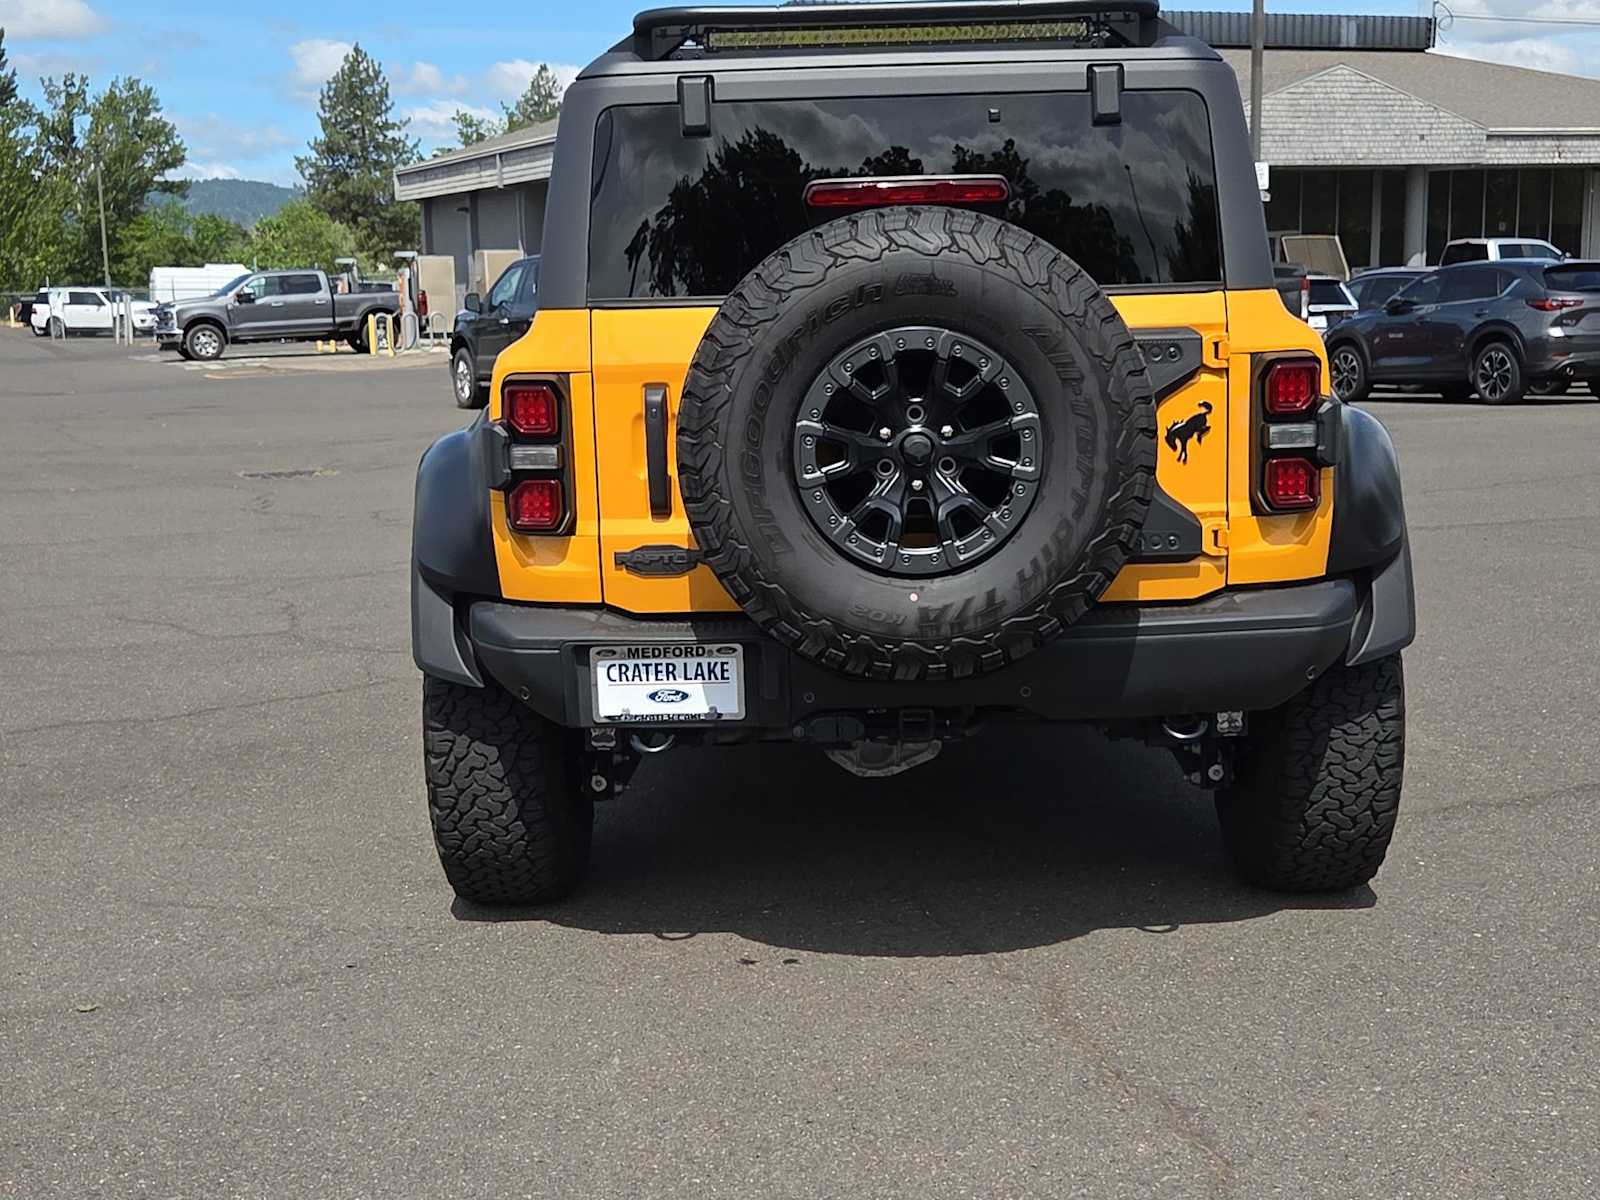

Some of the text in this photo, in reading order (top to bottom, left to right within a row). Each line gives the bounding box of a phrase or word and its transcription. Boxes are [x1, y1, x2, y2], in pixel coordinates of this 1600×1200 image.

[627, 646, 706, 659] MEDFORD
[606, 661, 730, 682] CRATER LAKE
[654, 690, 683, 703] Ford
